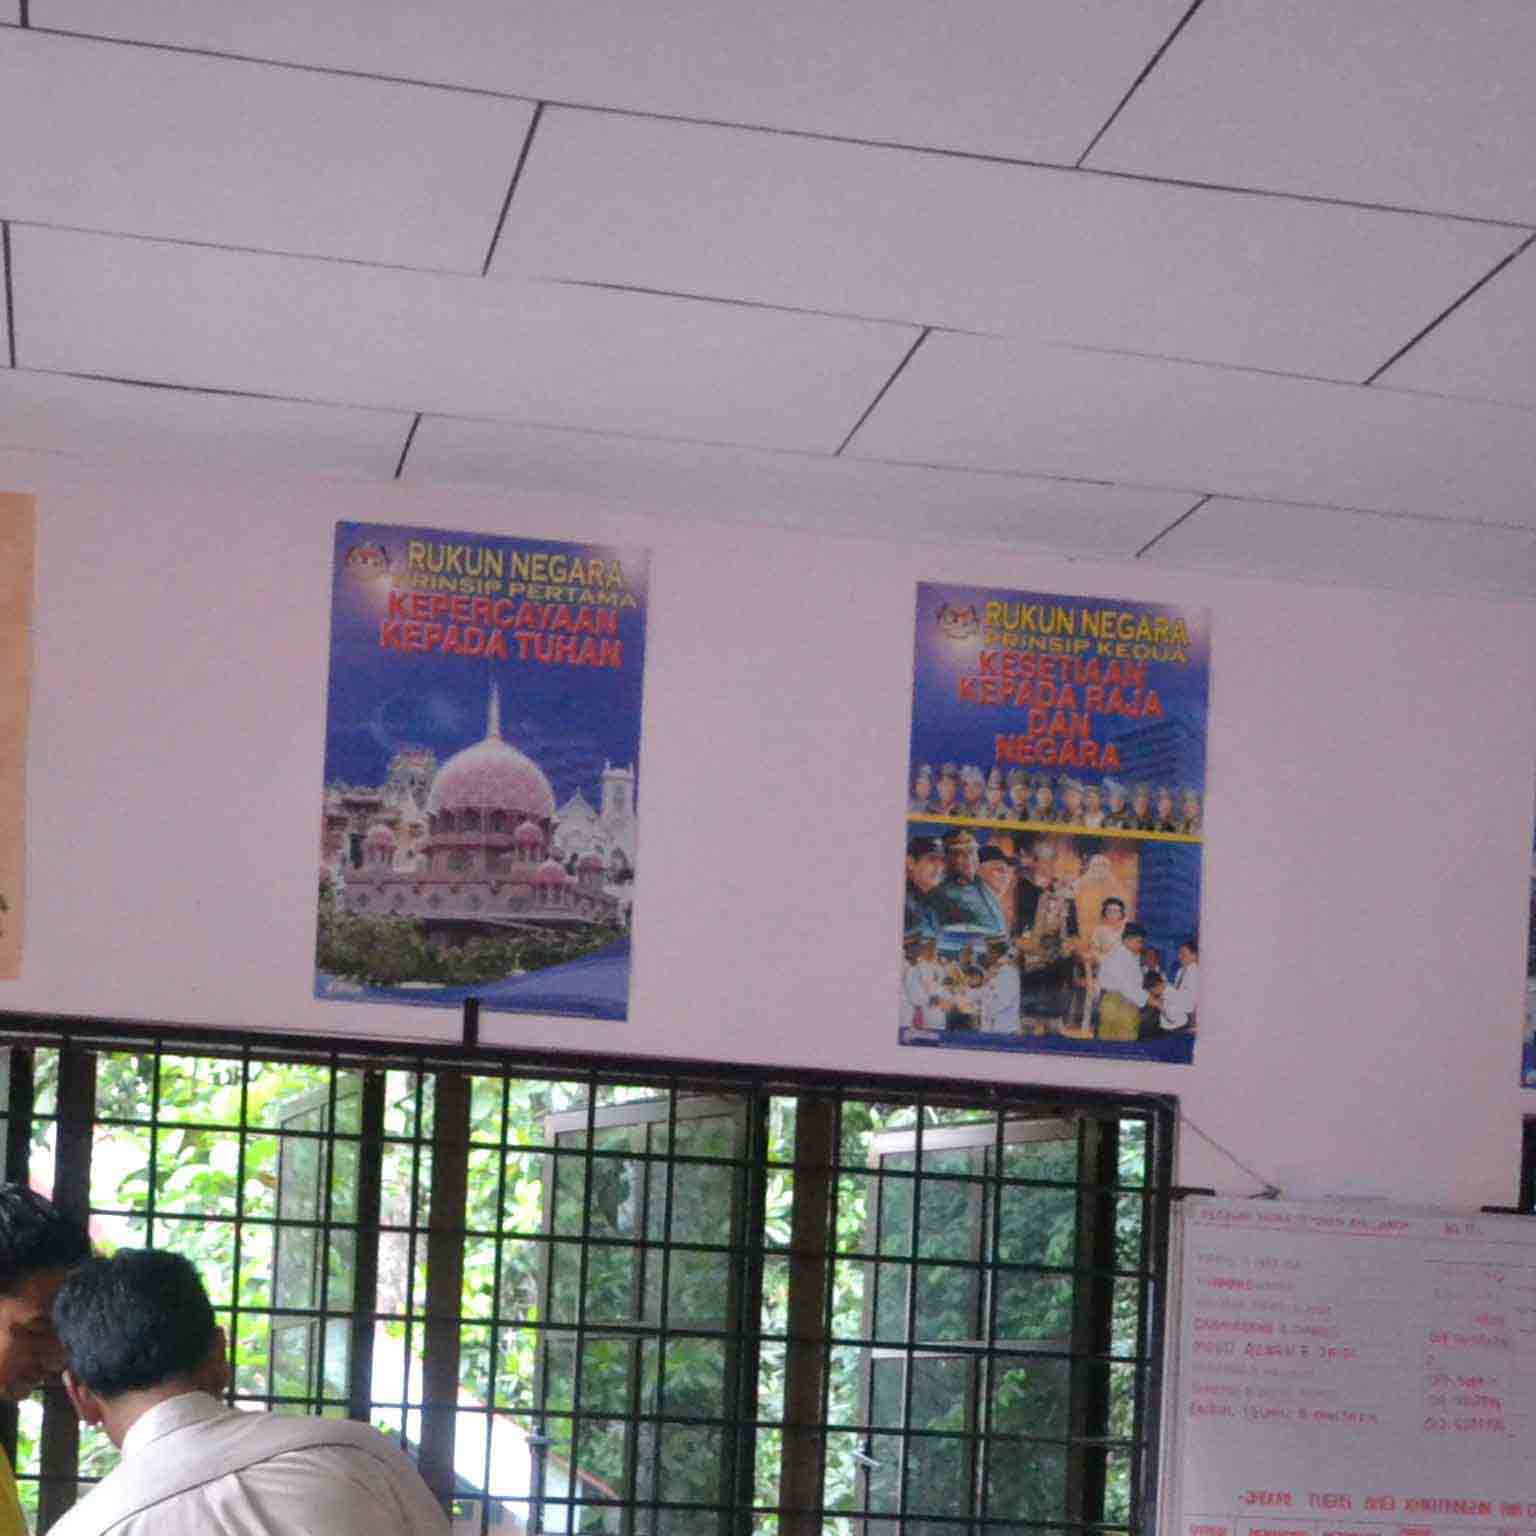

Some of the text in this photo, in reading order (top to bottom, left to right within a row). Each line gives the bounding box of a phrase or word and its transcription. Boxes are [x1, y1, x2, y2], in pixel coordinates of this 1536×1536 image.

[408, 541, 624, 591] RUKUN NEGARA
[387, 590, 619, 637] KEPERCAYAAN
[509, 582, 638, 608] PERTAMA
[984, 601, 1190, 646] RUKUN NEGARA
[378, 622, 624, 669] KEPADA TUHAN
[983, 632, 1189, 663] PRINSIP KEDUA
[977, 649, 1148, 688] KESETIAAN
[958, 677, 1163, 720] KEPADA RAJA
[1026, 709, 1092, 741] DAN
[994, 734, 1121, 771] NEGARA
